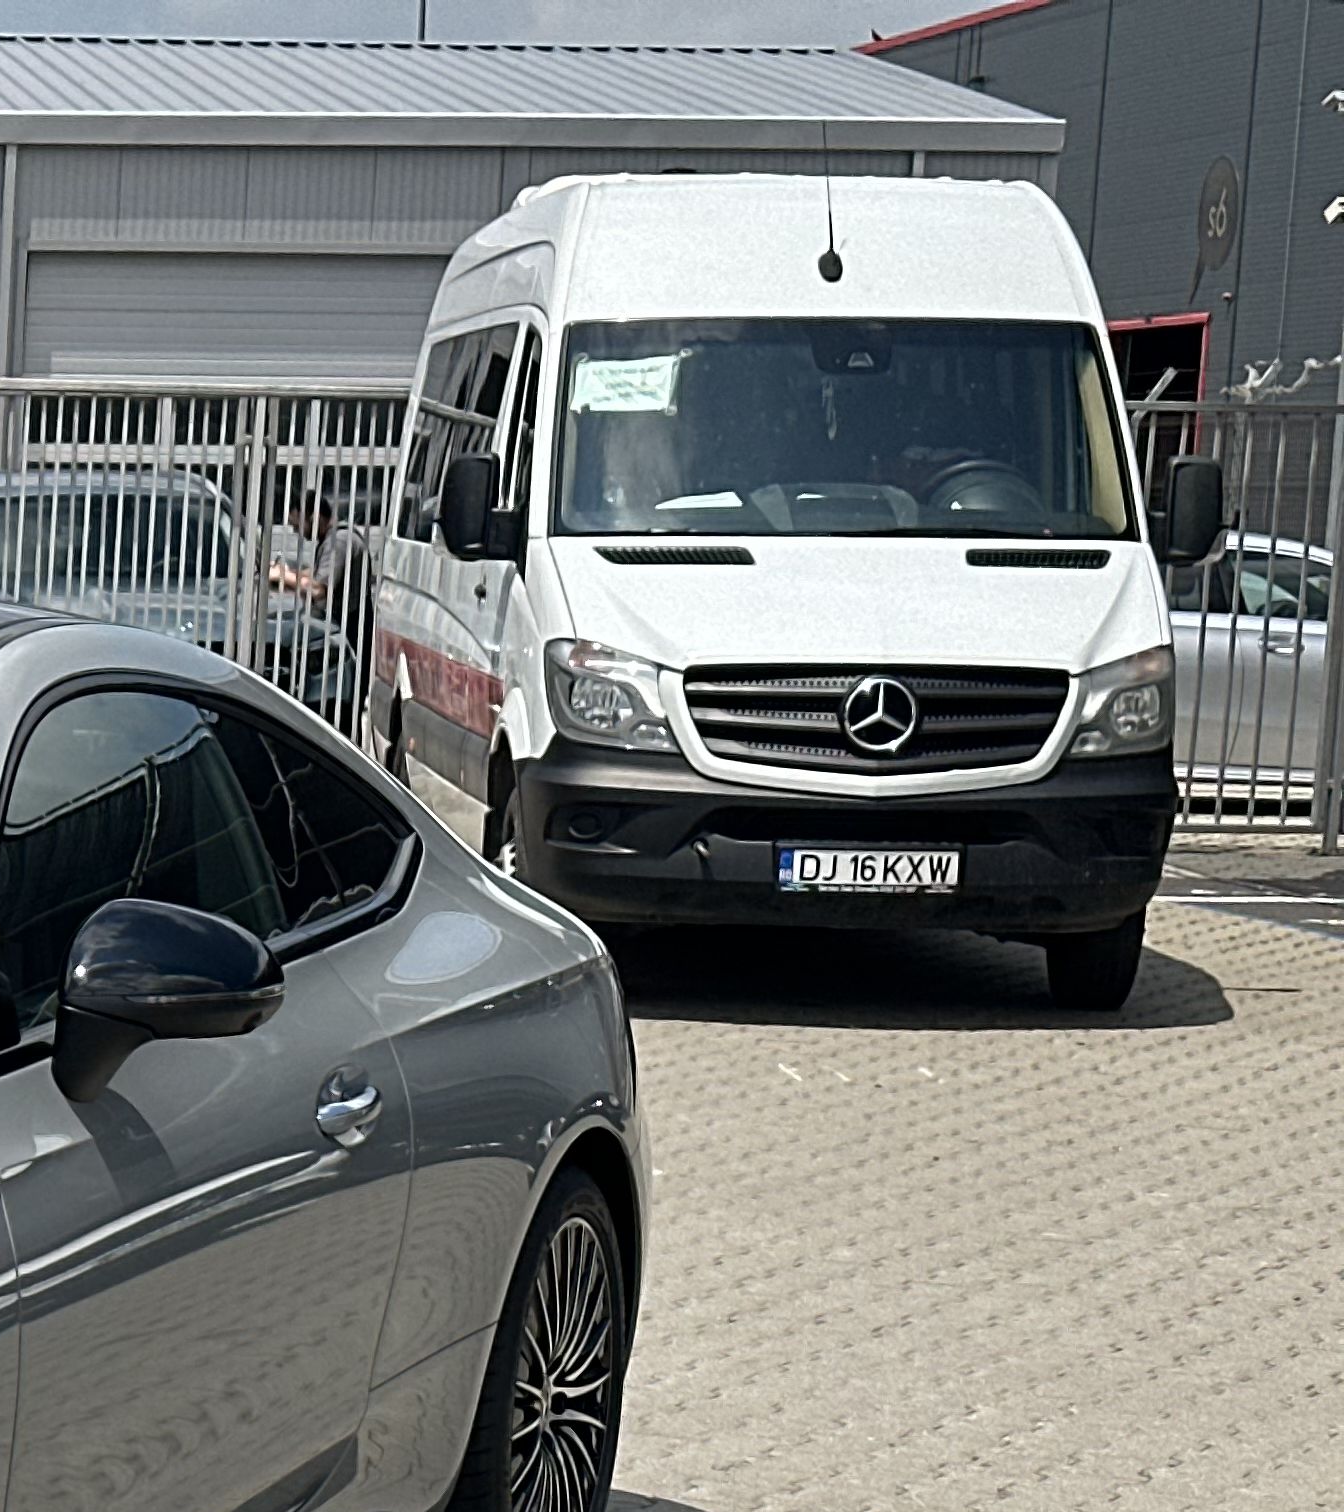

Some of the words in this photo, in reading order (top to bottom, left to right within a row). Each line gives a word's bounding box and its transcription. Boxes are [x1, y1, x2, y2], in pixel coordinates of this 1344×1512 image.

[799, 854, 838, 882] DJ
[849, 854, 876, 882] 16
[883, 855, 952, 883] KXW
